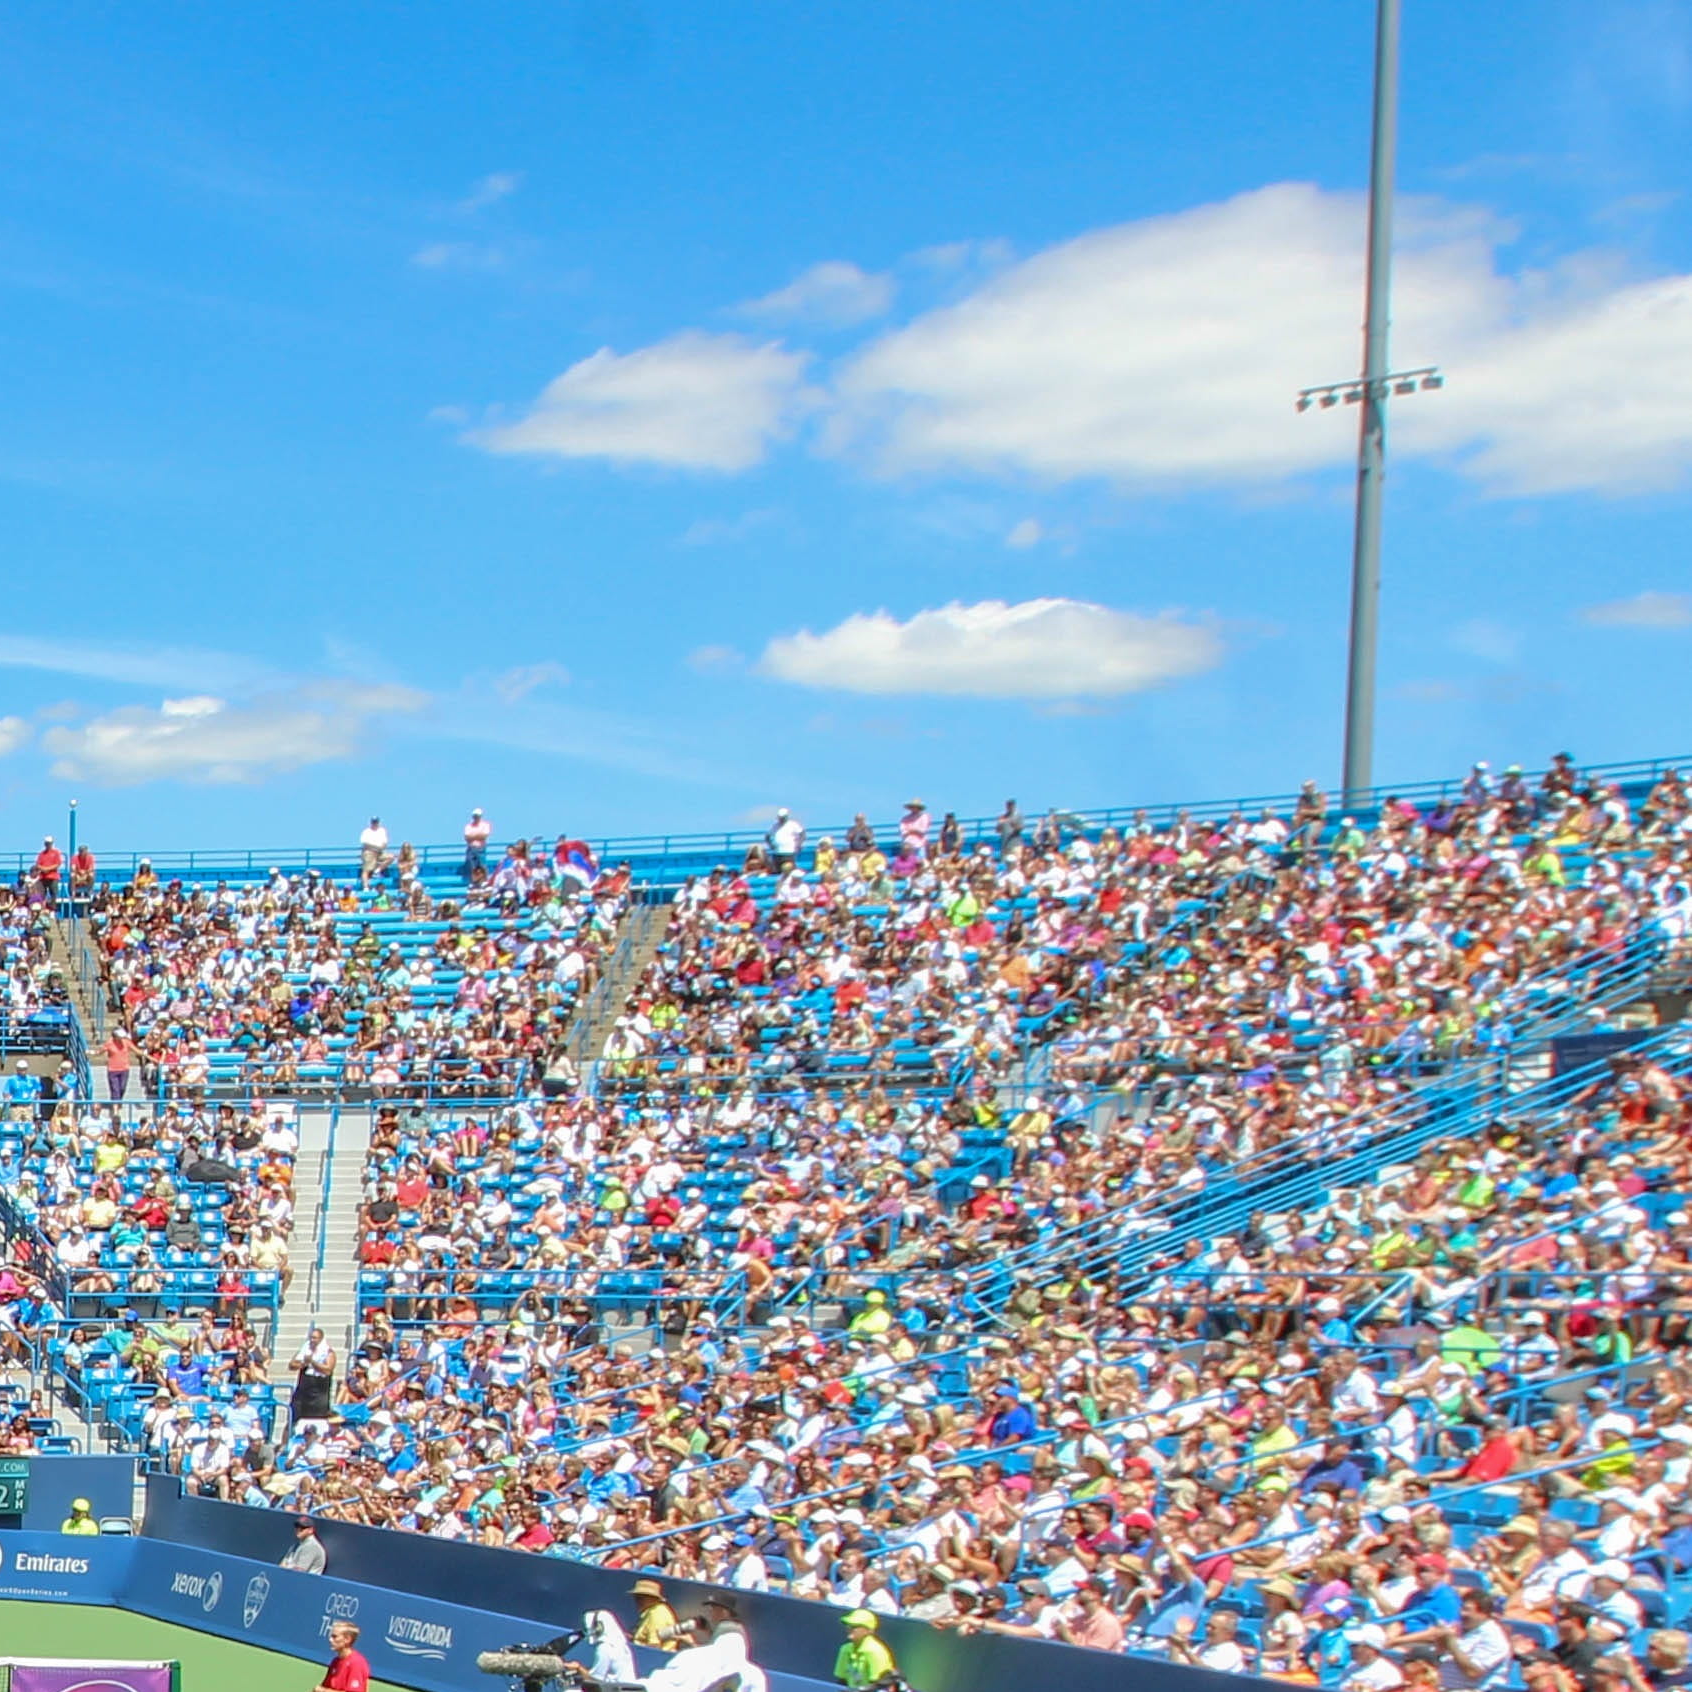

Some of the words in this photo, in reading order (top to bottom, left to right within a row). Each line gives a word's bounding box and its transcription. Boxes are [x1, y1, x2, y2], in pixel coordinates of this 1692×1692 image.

[15, 1552, 90, 1575] Emirates
[171, 1571, 206, 1599] xerox
[325, 1592, 360, 1619] OREO
